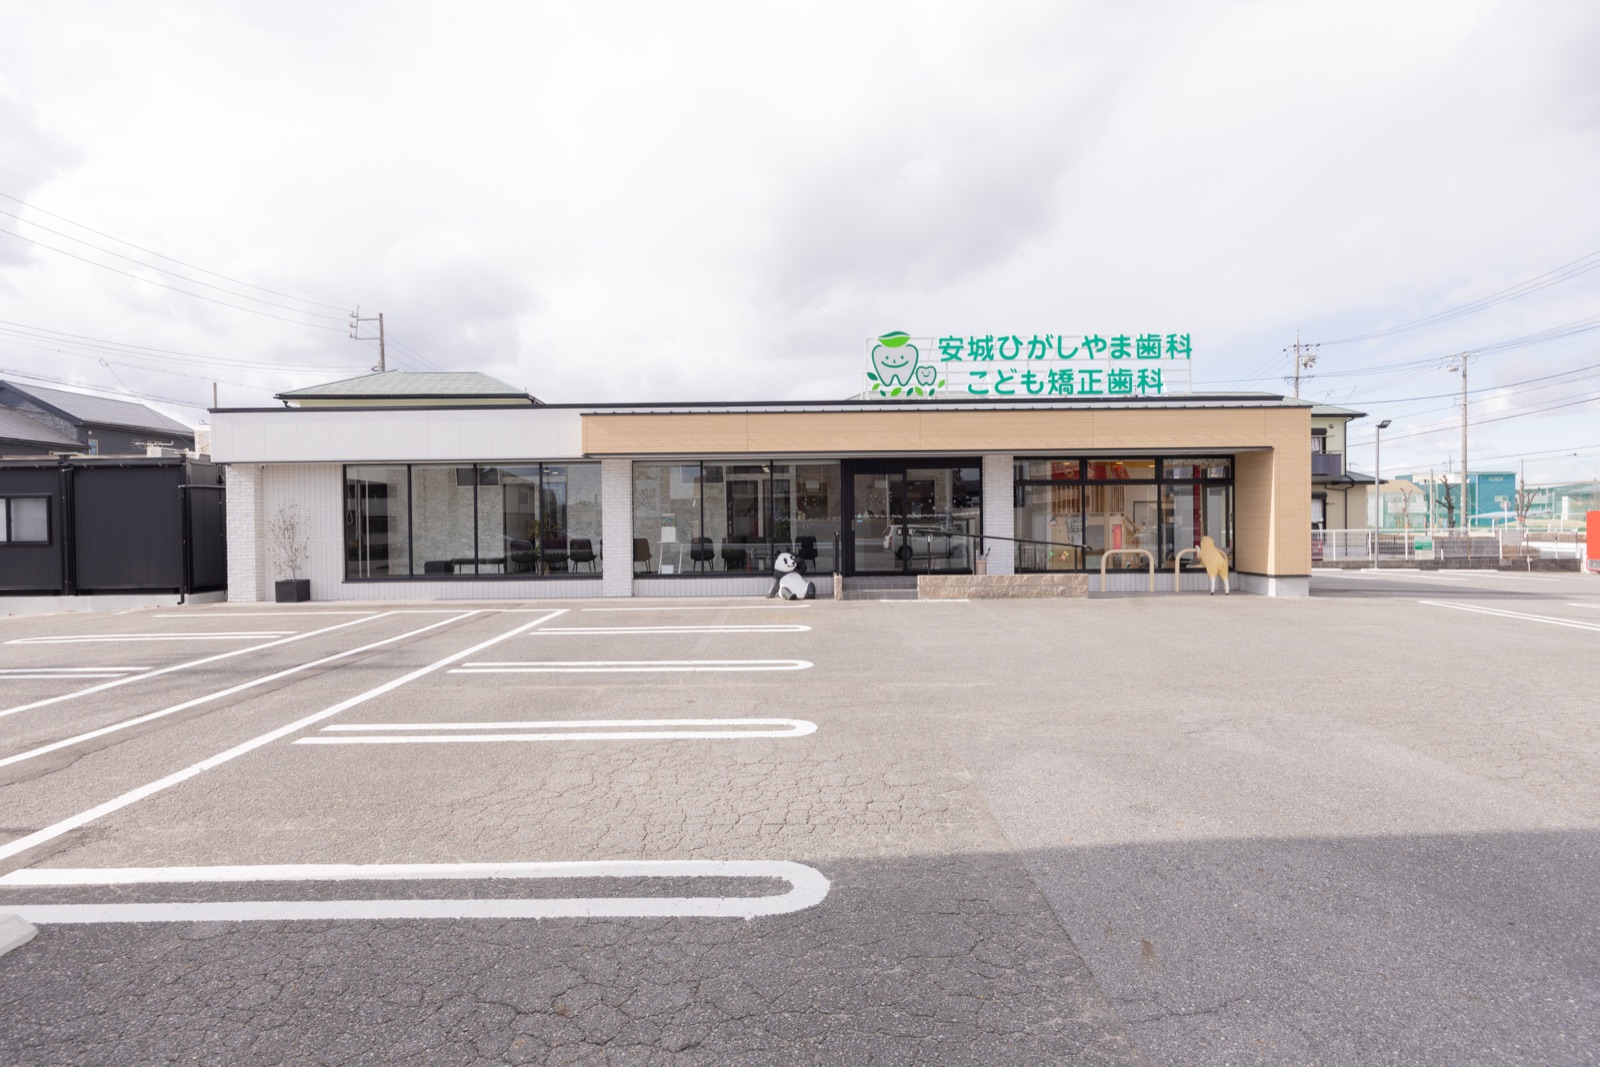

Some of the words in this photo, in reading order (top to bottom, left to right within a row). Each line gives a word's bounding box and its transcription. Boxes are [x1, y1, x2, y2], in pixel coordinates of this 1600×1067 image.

[937, 332, 1194, 362] 安城ひがしやま歯科
[967, 368, 1164, 396] こども矯正歯科
